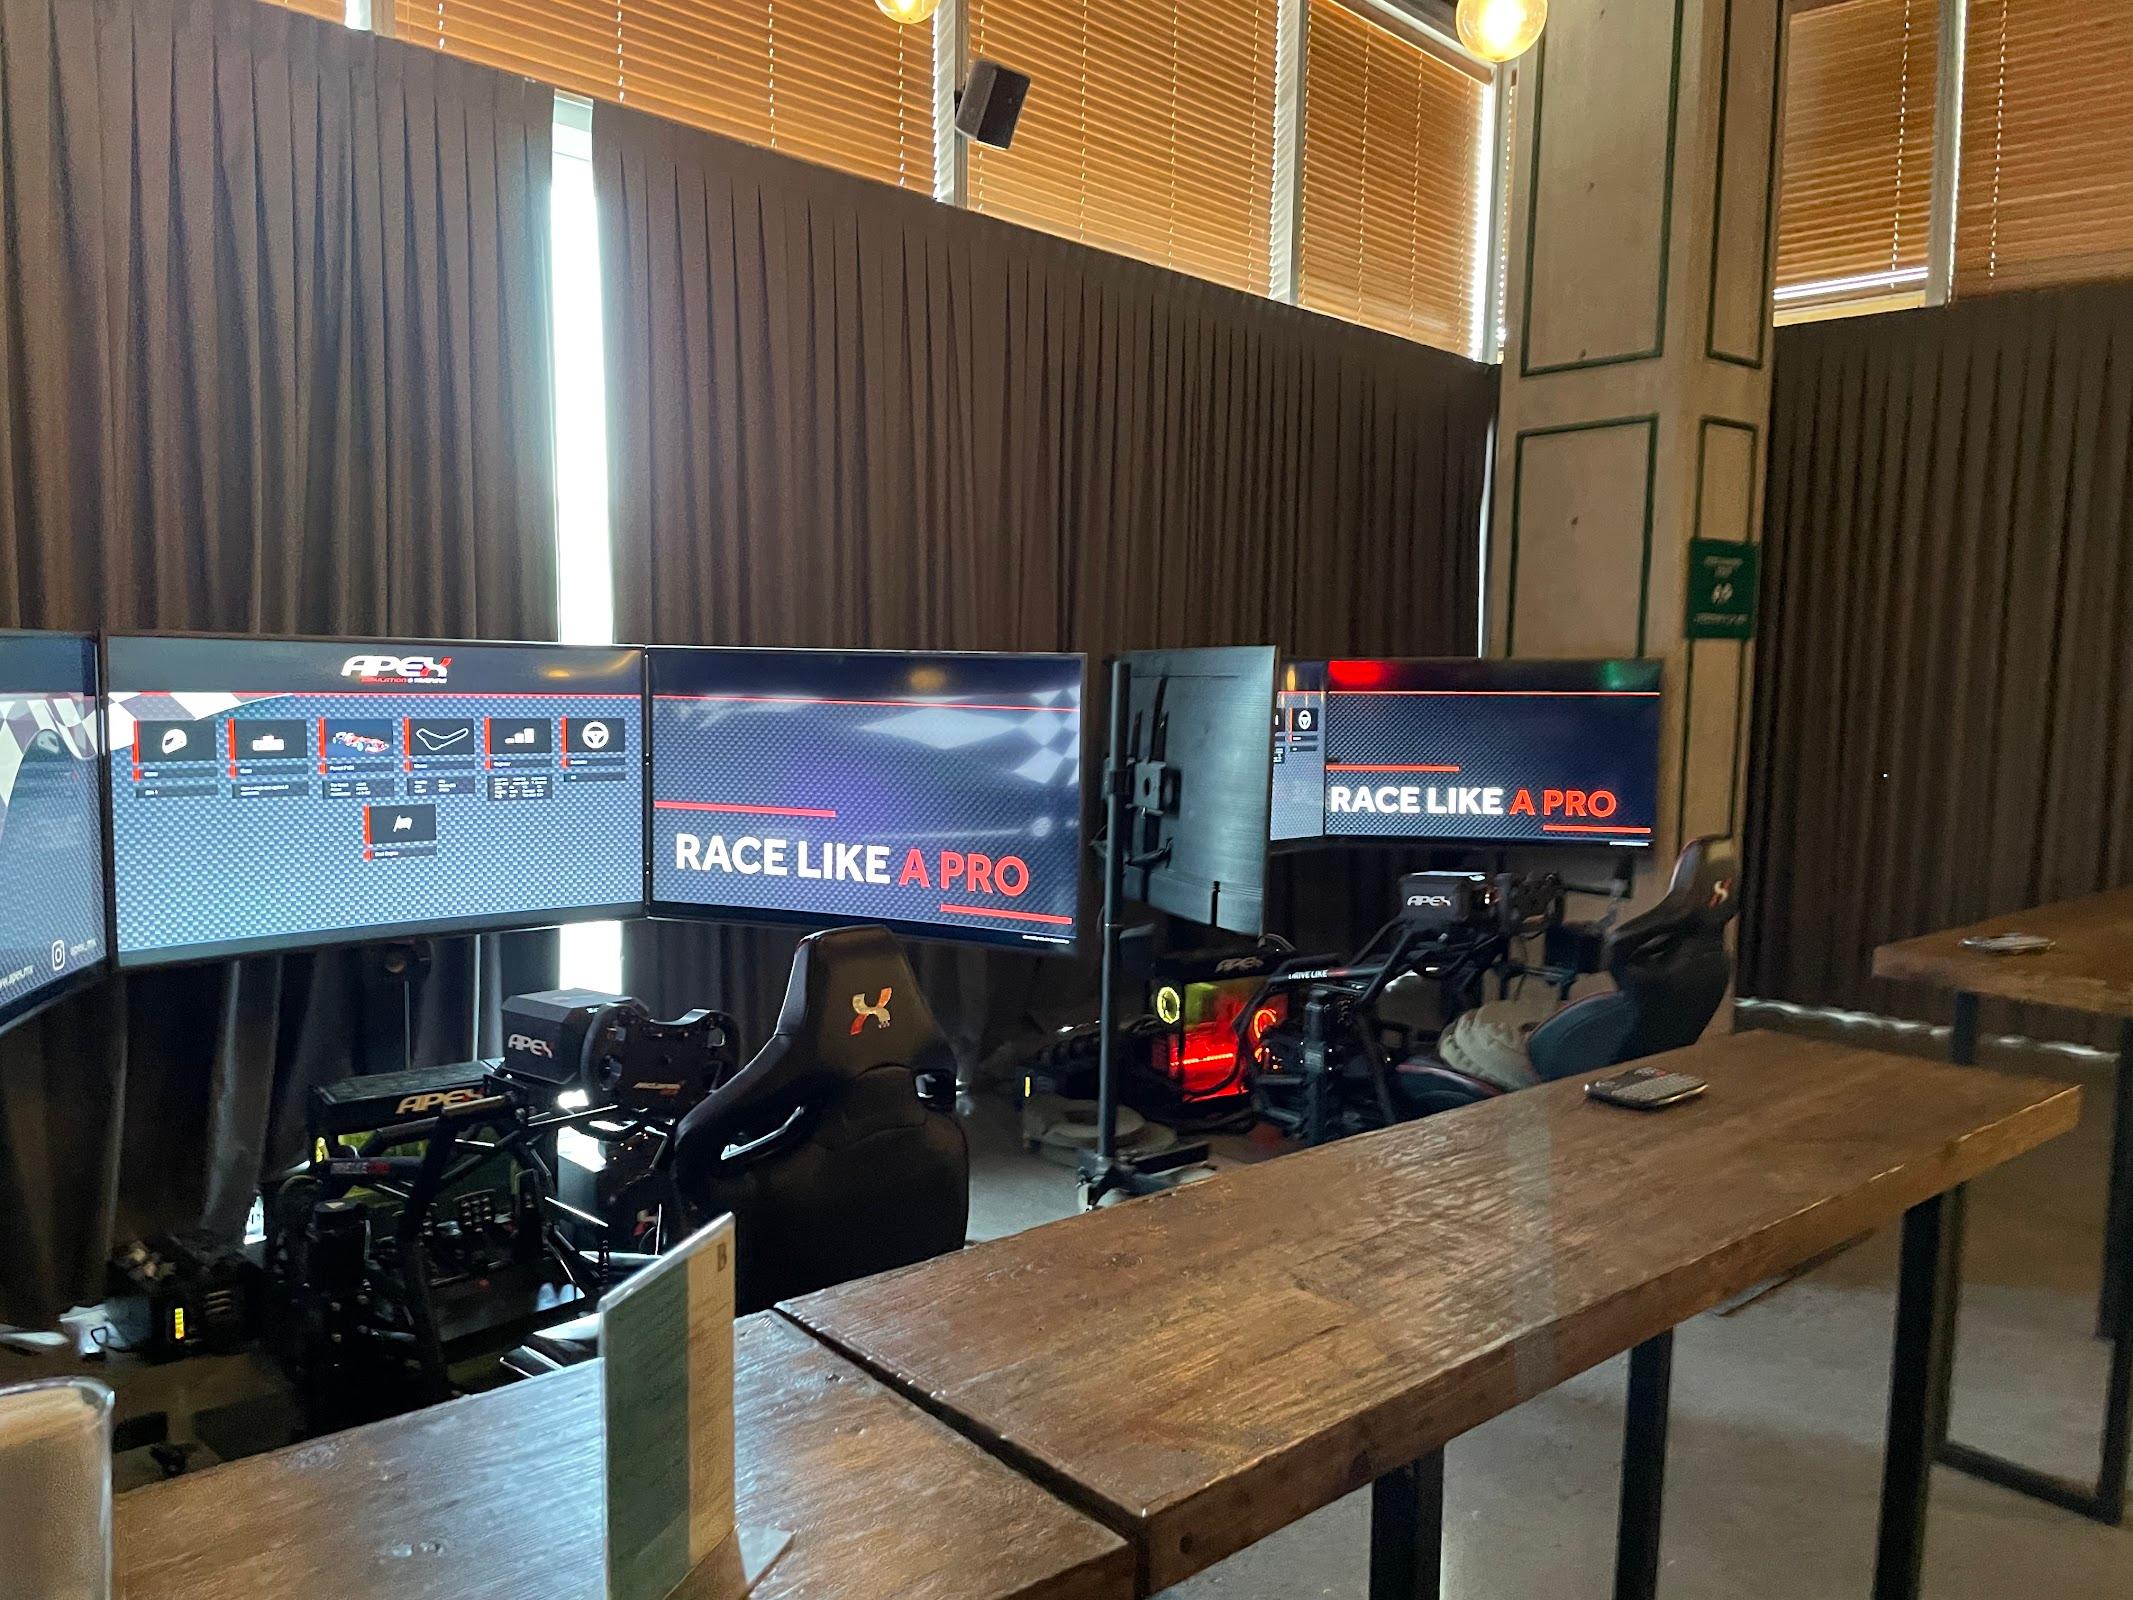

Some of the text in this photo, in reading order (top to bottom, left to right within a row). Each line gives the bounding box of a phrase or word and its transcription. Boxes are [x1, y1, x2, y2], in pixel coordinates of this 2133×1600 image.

[340, 655, 452, 677] APEX
[1330, 786, 1617, 818] RACE LIKE A PRO
[675, 833, 1030, 897] RACE LIKE A PRO
[1407, 895, 1451, 906] APEX
[1311, 969, 1329, 978] LIKE
[508, 1033, 553, 1059] APEX
